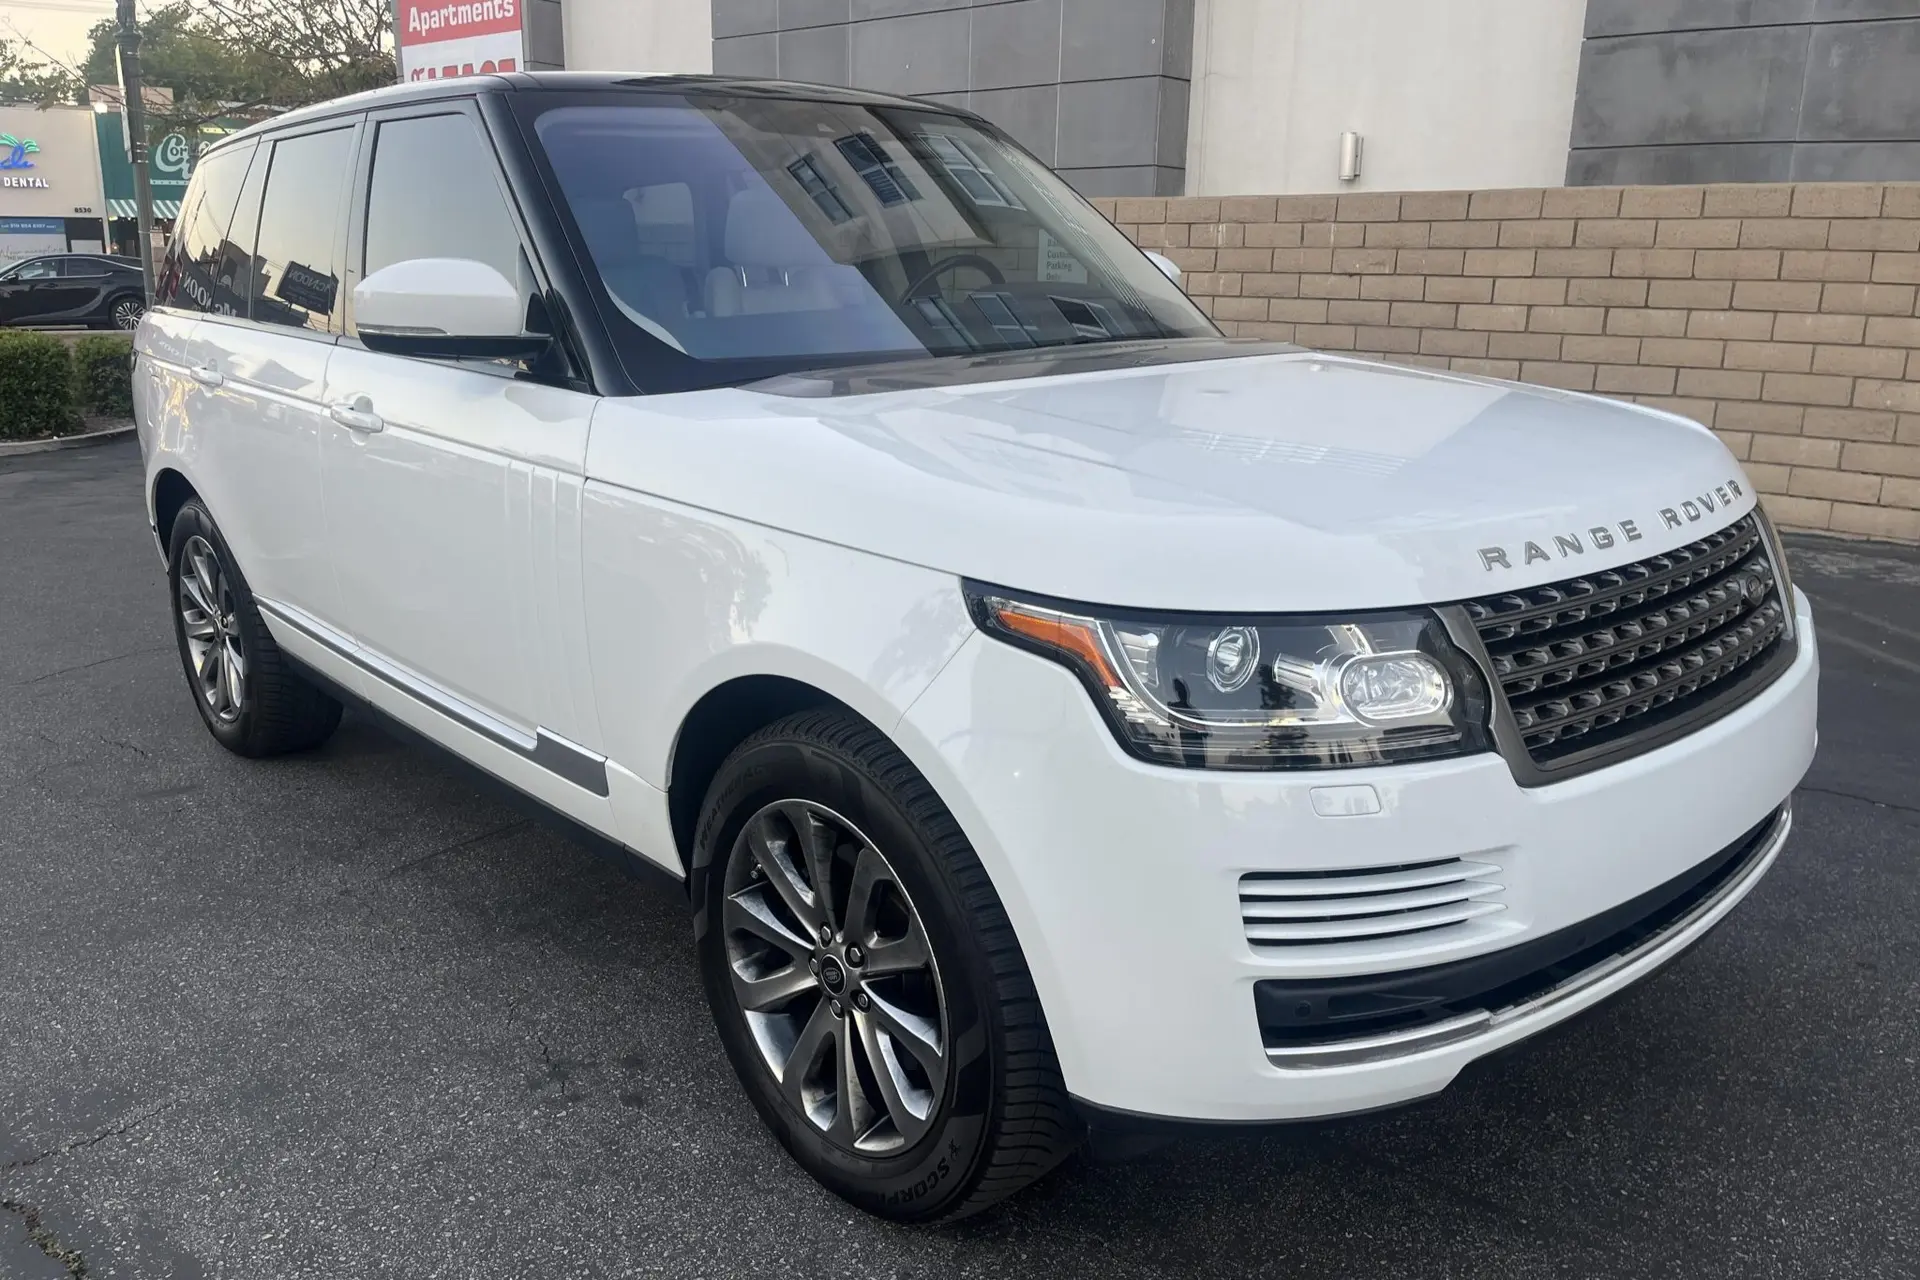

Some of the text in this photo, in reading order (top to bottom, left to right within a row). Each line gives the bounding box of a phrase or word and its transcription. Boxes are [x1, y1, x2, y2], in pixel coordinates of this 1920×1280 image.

[408, 0, 515, 37] Apartments
[3, 176, 50, 188] DENTAL
[1476, 478, 1744, 572] RANGE ROVER
